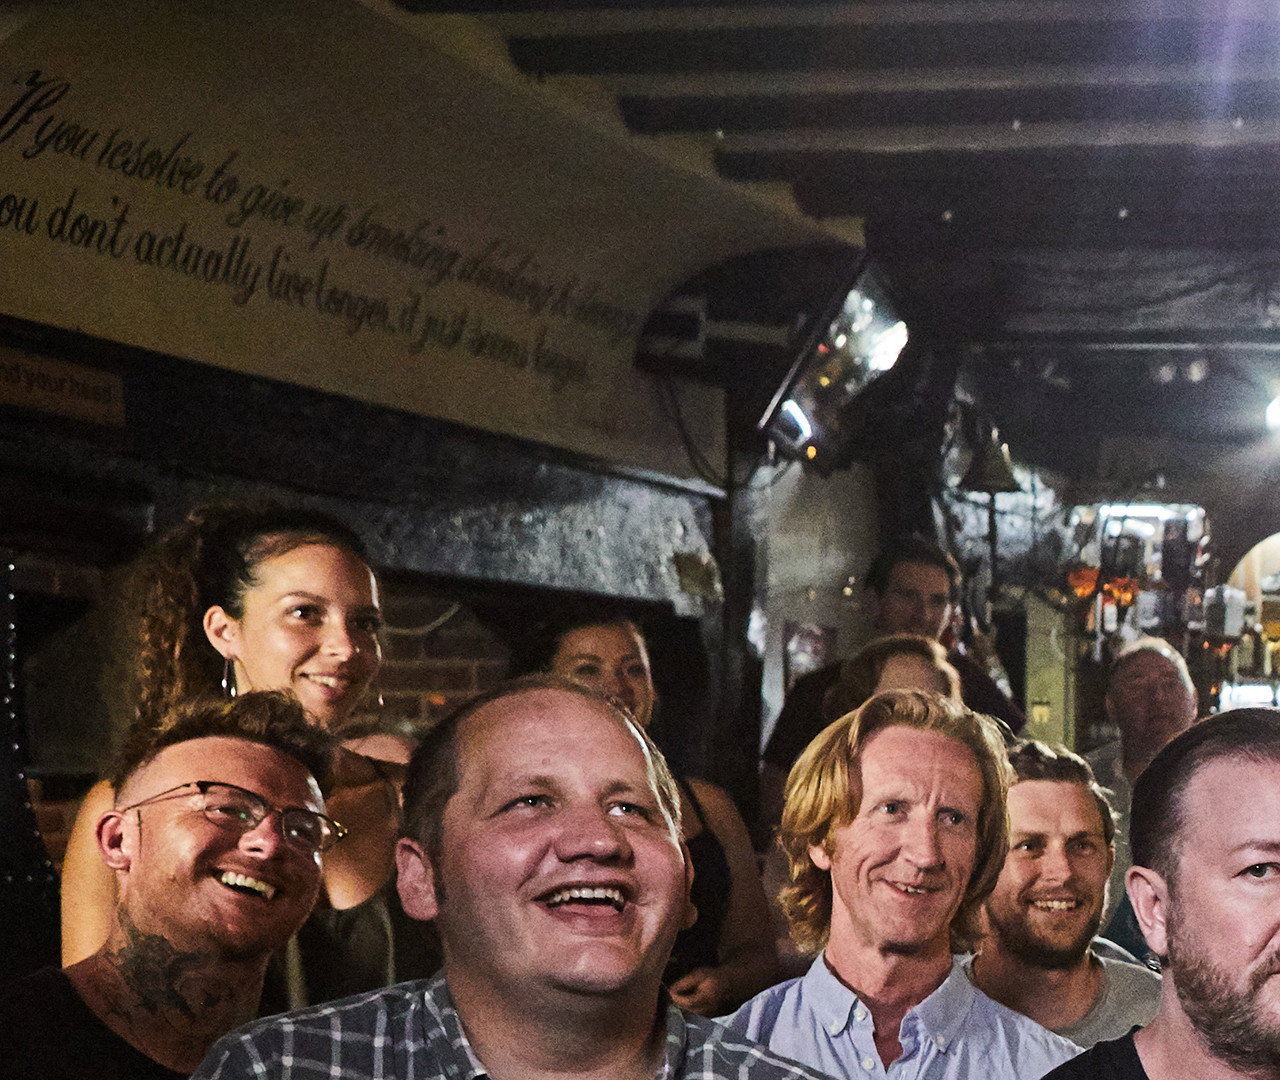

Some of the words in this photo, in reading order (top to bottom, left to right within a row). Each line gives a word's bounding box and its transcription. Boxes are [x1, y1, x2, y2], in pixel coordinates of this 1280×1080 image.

[0, 70, 70, 142] If
[23, 115, 99, 159] you
[98, 128, 204, 195] resolve
[205, 149, 239, 203] to
[226, 179, 304, 228] give
[305, 203, 347, 252] up
[47, 188, 129, 258] don't
[135, 222, 262, 307] actually
[267, 245, 313, 307] live
